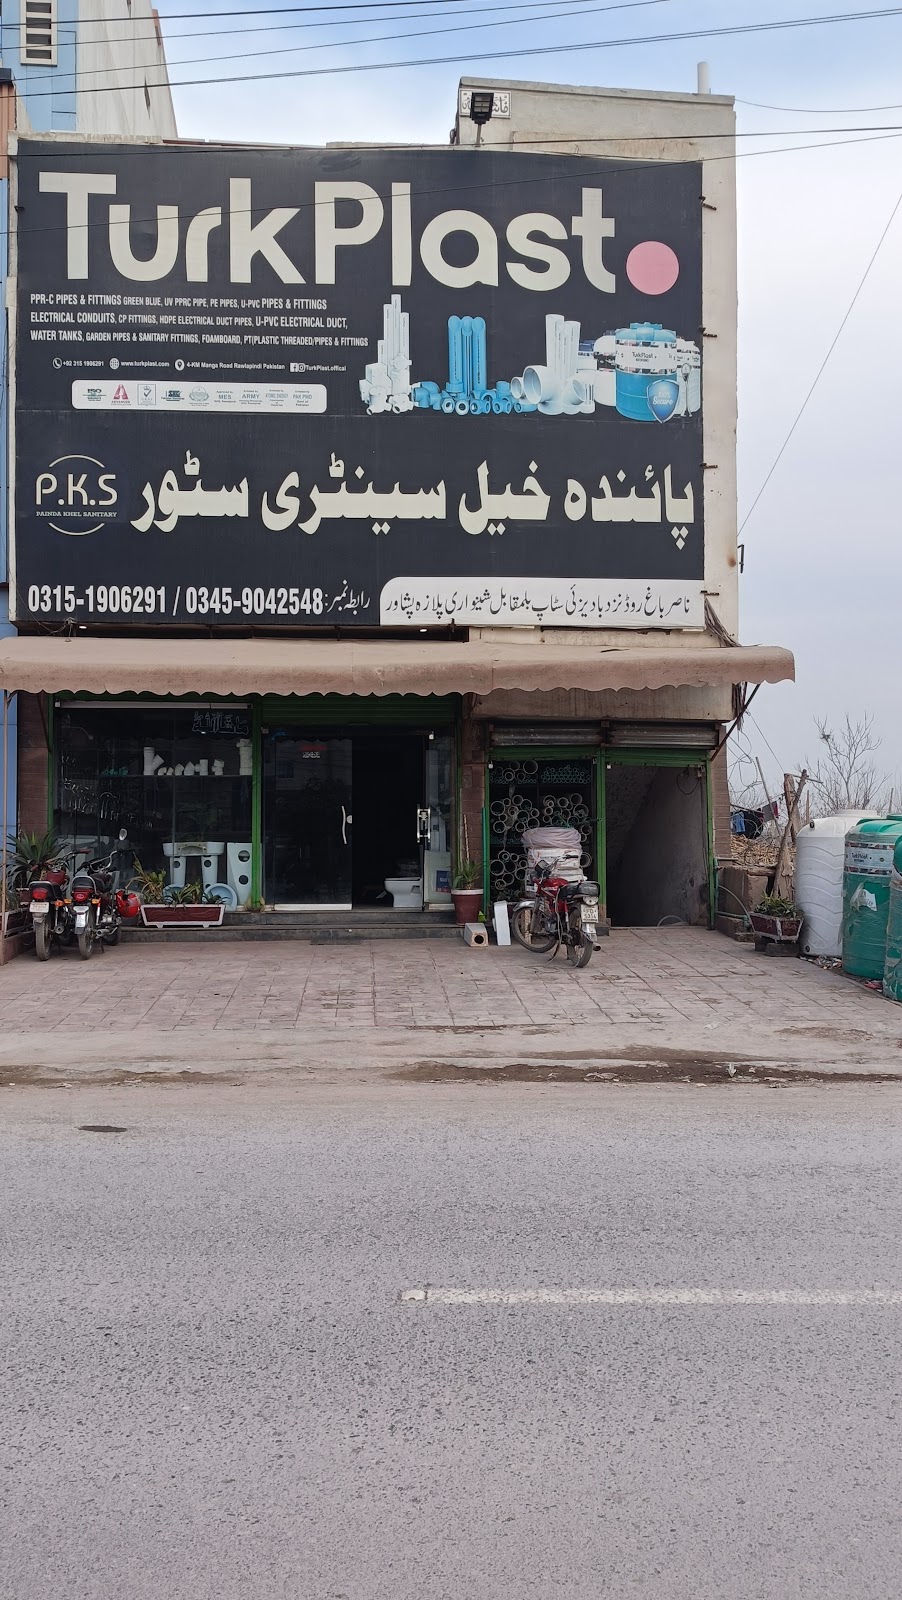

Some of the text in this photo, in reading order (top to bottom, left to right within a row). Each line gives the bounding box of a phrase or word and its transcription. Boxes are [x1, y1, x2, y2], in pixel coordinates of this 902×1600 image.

[30, 293, 327, 310] PPR-C PIPES & FITTINGS GREEN BLUE, UV PPRC PIPE, PE PIPES, U-PVC PIPES & FITTINGS
[30, 312, 348, 329] ELECTRICAL CONDUITS, CP FITTINGS, HDPE ELECTRICAL DUCT PIPES, U-PVC ELECTRICAL DUCT,
[30, 330, 57, 341] WATER
[58, 330, 85, 342] TANKS,
[86, 332, 111, 341] GARDEN
[112, 332, 131, 342] PIPES
[132, 333, 137, 342] &
[138, 332, 169, 343] SANITARY
[170, 333, 201, 344] FITTINGS,
[201, 334, 243, 345] FOAMBOARD,
[334, 336, 339, 347] &
[340, 337, 369, 347] FITTINGS
[36, 473, 118, 506] P.K.S
[130, 450, 249, 533] سٹور
[261, 452, 447, 535] سینٹری
[458, 459, 551, 536] خیل
[27, 584, 166, 613] 0315-1906291
[185, 586, 323, 616] 0345-9042548
[385, 592, 415, 619] پشاور
